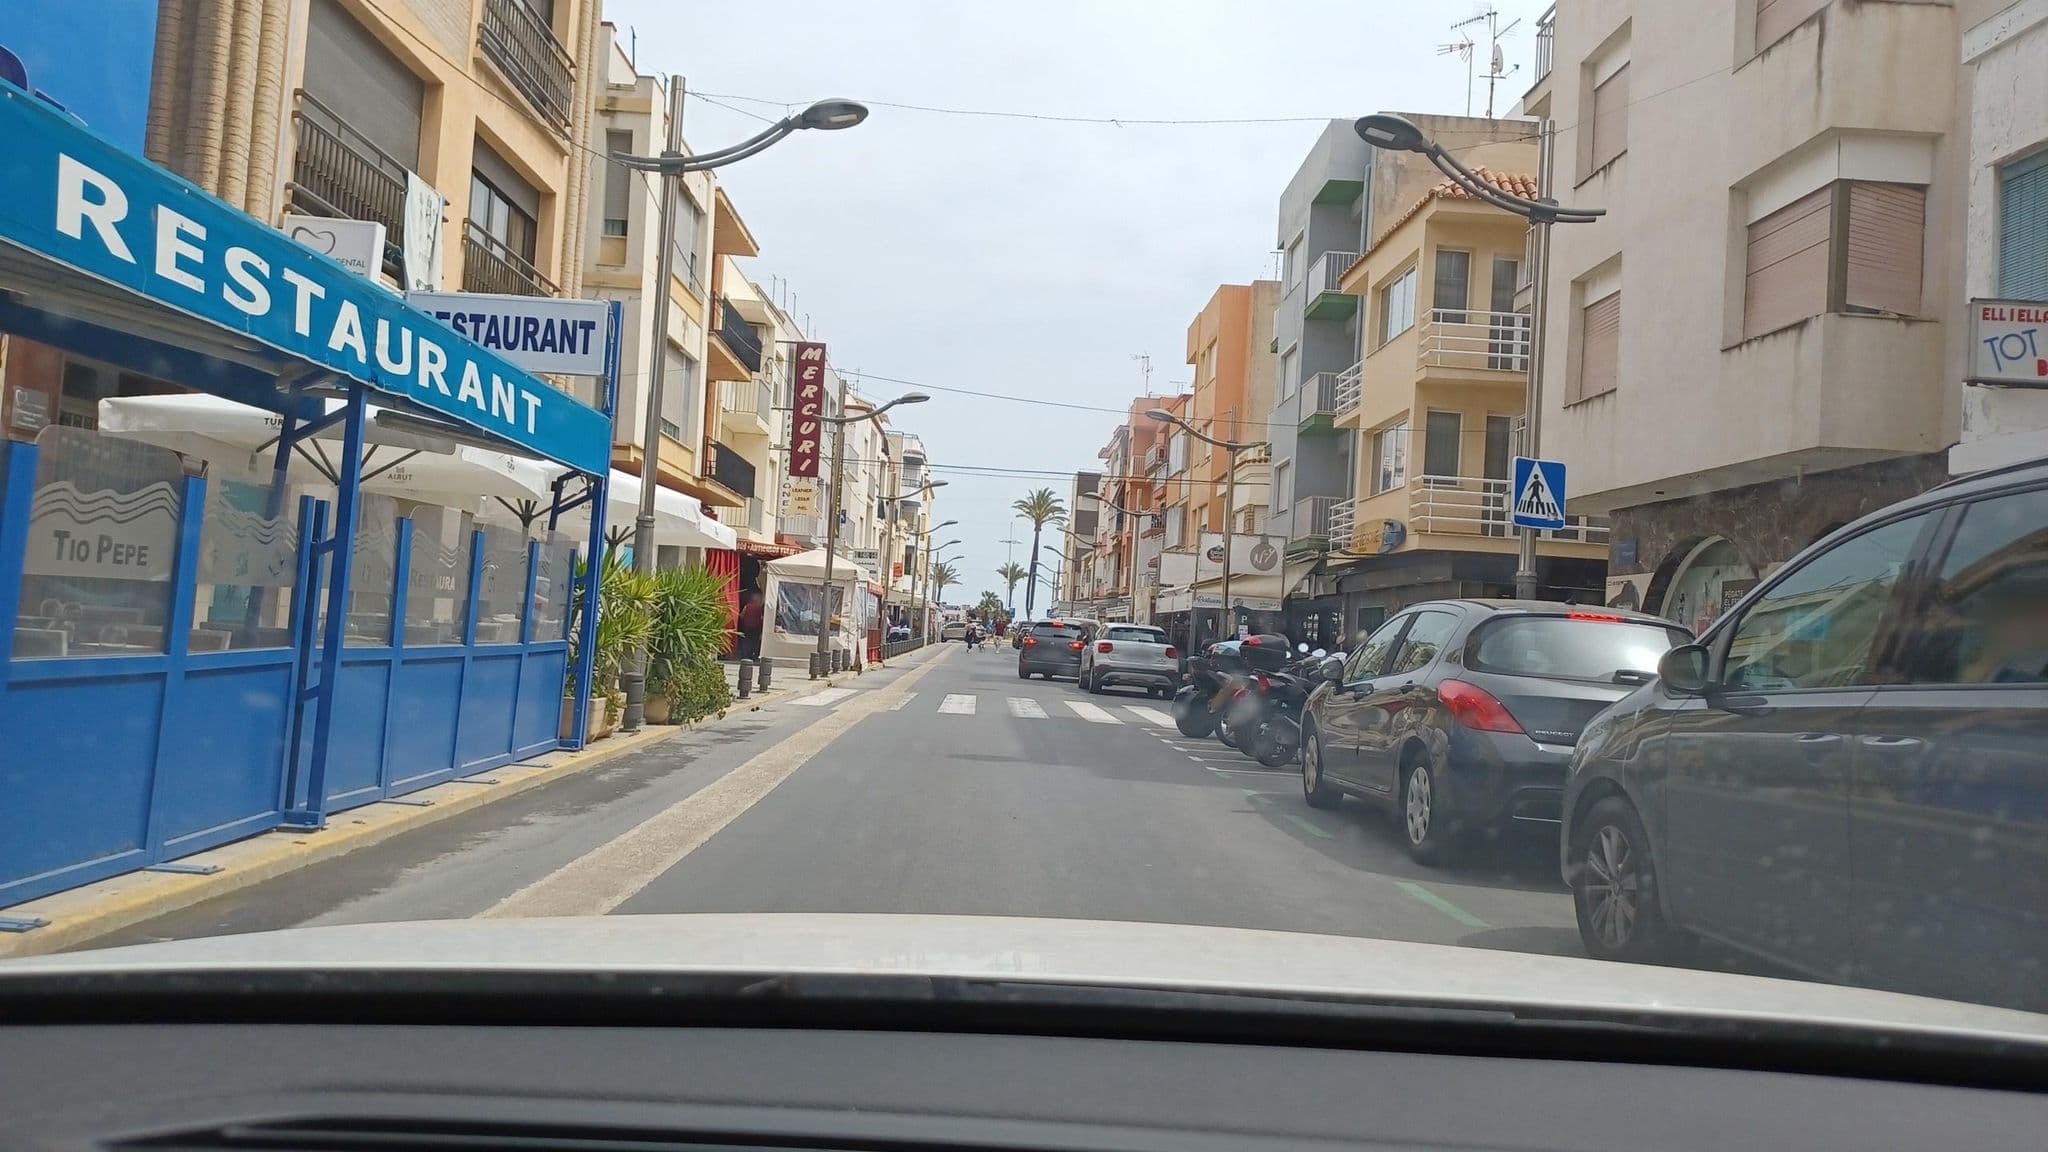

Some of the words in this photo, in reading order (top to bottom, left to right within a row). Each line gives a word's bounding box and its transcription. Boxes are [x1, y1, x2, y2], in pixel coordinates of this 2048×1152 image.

[56, 152, 542, 435] RESTAURANT
[1982, 307, 2006, 321] ELL
[424, 310, 596, 355] STAURANT
[1983, 328, 2037, 373] TOT
[798, 347, 823, 472] MERCURI
